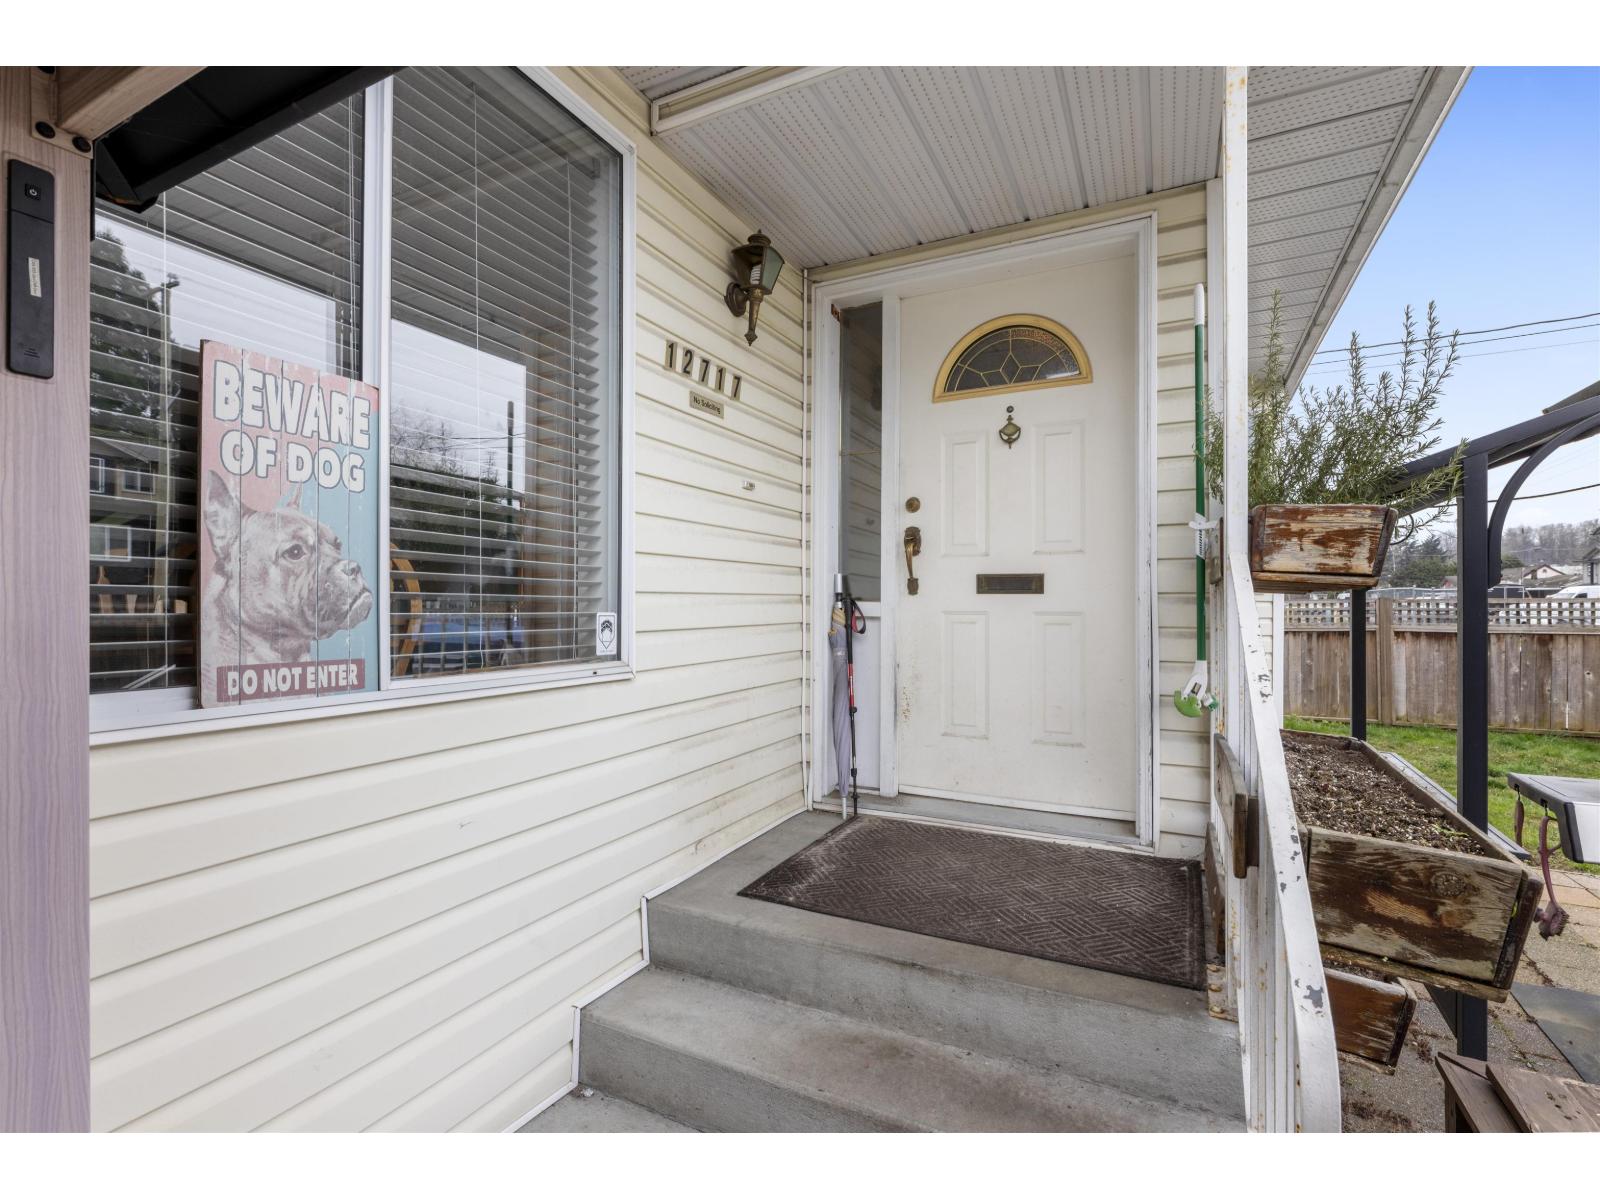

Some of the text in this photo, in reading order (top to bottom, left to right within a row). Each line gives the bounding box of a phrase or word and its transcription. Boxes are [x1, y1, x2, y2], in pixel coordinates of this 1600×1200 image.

[668, 343, 741, 398] 12717
[214, 360, 371, 449] BEWARE
[693, 396, 701, 405] No
[220, 430, 366, 493] OF DOG
[227, 663, 359, 696] DO NOT ENTER
